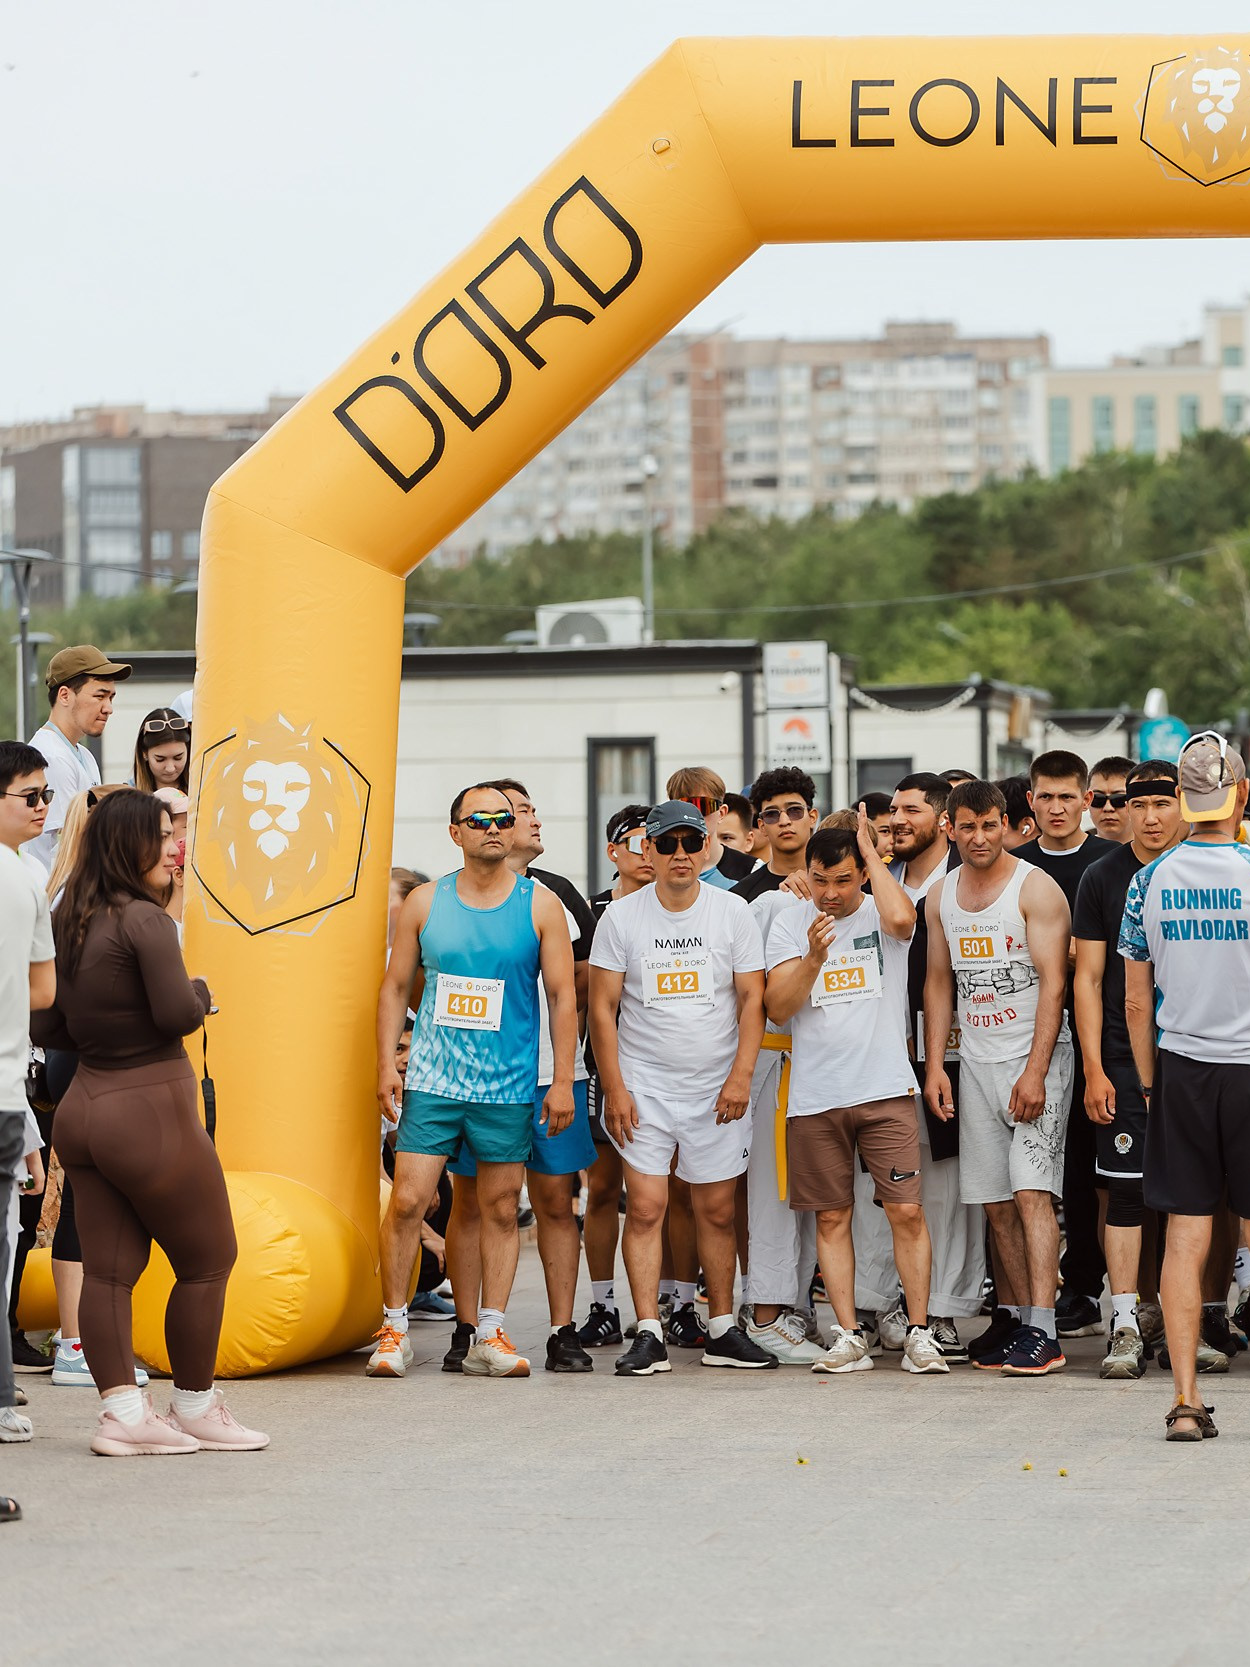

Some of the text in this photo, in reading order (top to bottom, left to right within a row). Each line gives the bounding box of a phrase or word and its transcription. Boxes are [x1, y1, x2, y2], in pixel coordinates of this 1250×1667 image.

[792, 76, 1118, 148] LEONE
[1161, 888, 1242, 910] RUNNING
[655, 937, 702, 949] NAIMAN
[963, 940, 989, 955] 501
[647, 961, 672, 970] LEONE
[822, 959, 838, 967] ONE
[442, 980, 463, 990] LEONE
[661, 974, 695, 991] 412
[828, 969, 862, 989] 334
[972, 992, 995, 1003] AGAIN
[450, 996, 483, 1015] 410
